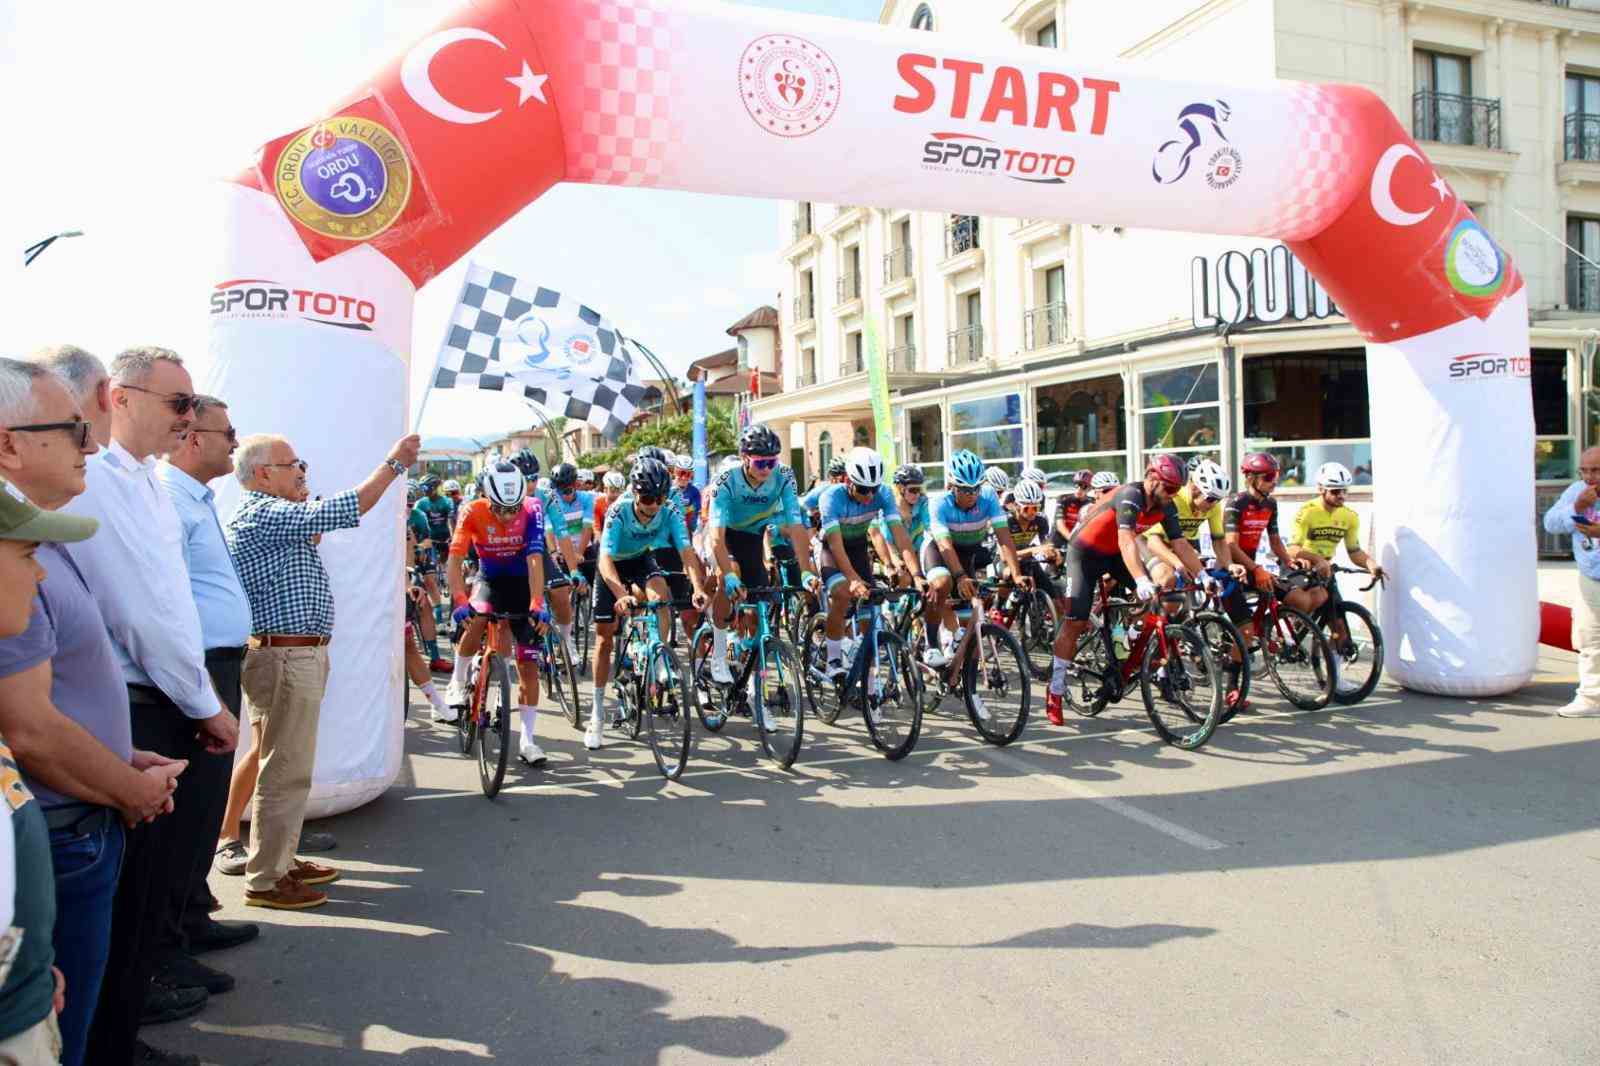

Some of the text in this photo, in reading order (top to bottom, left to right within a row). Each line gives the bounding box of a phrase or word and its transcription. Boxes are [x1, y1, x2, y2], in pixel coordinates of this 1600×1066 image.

[893, 53, 1121, 136] START
[282, 142, 309, 182] ORDU
[317, 152, 360, 180] ORDU
